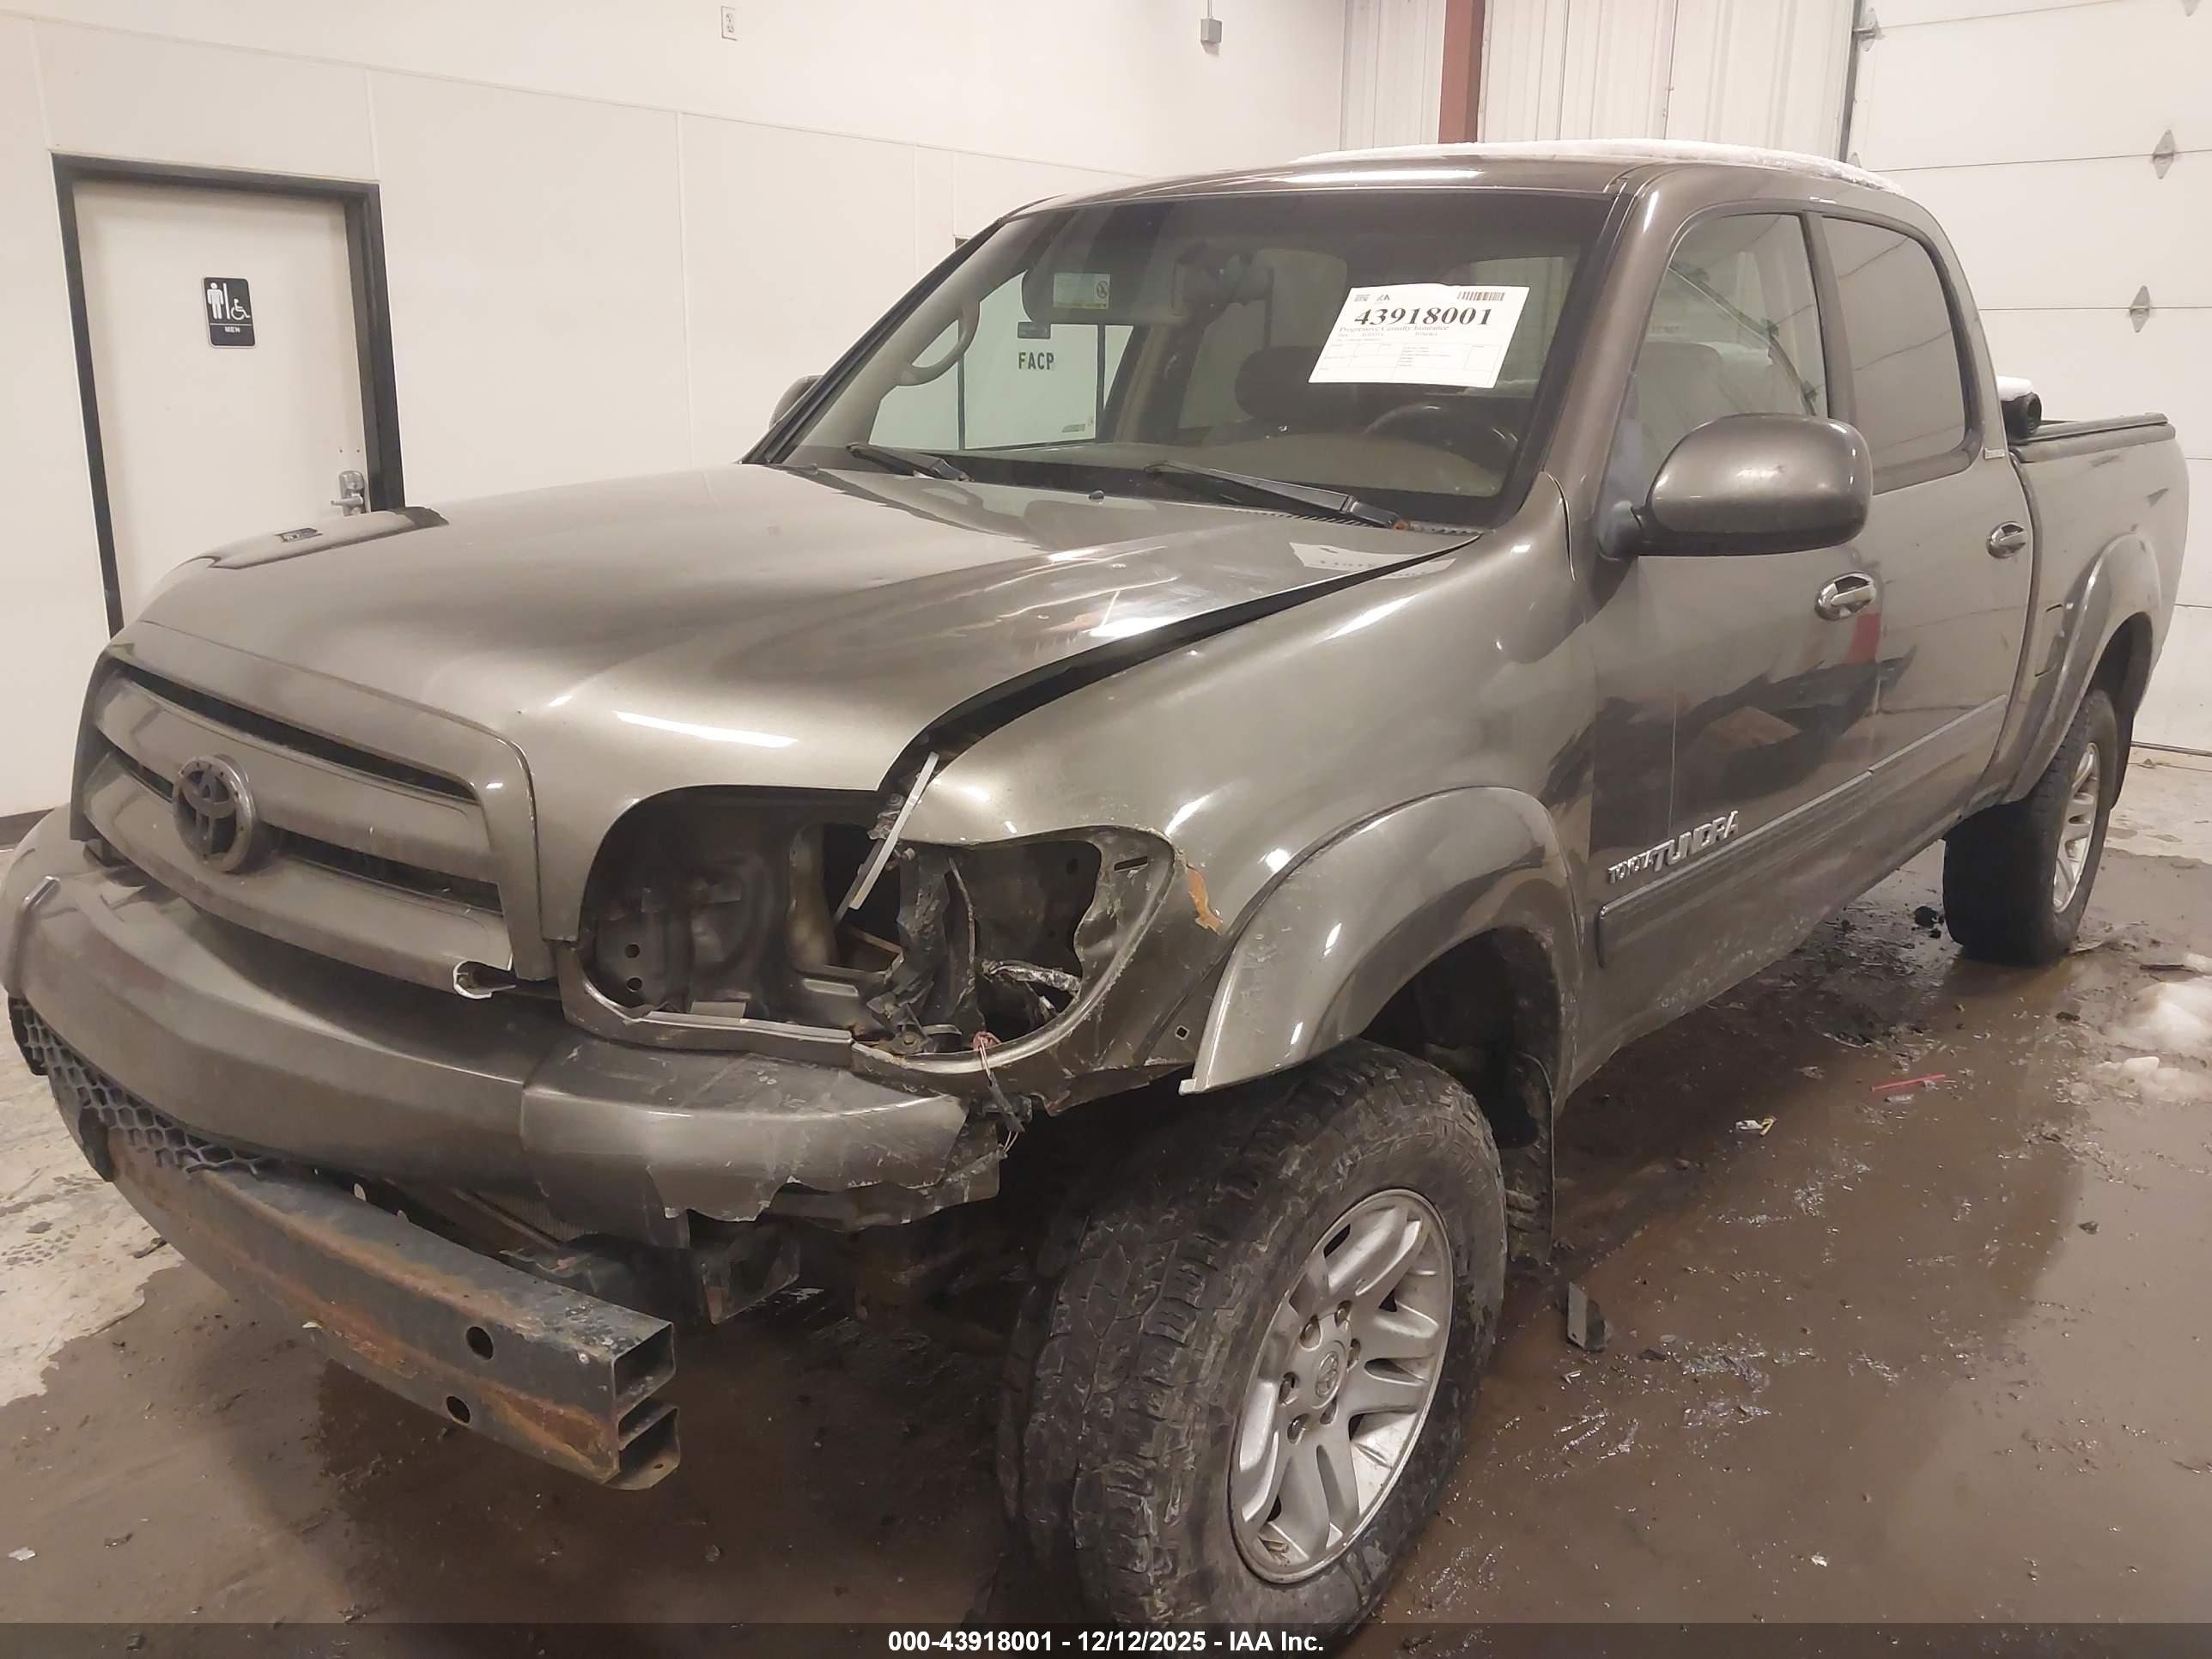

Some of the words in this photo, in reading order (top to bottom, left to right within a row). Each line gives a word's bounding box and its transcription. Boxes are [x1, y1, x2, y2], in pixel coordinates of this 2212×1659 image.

[1354, 307, 1492, 325] 43918001
[1018, 351, 1054, 370] FACP
[1650, 810, 1739, 872] TUNDRA
